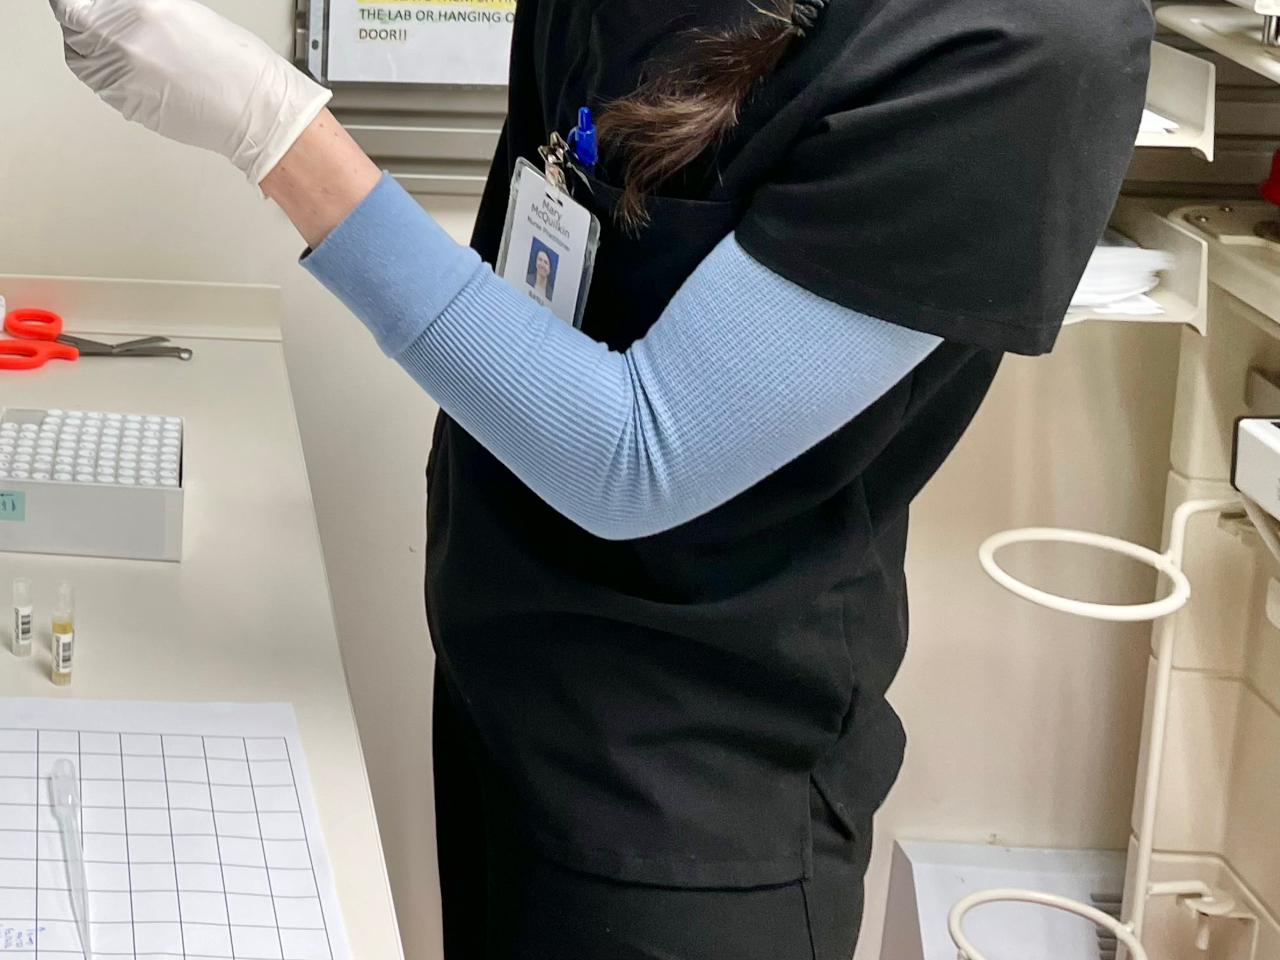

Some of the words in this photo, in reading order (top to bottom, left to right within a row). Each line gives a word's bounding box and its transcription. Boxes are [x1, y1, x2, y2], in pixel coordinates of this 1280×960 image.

[359, 9, 384, 20] THE
[388, 9, 412, 21] LAB
[415, 10, 434, 21] OR
[438, 10, 501, 23] HANGING
[542, 199, 563, 221] Mary
